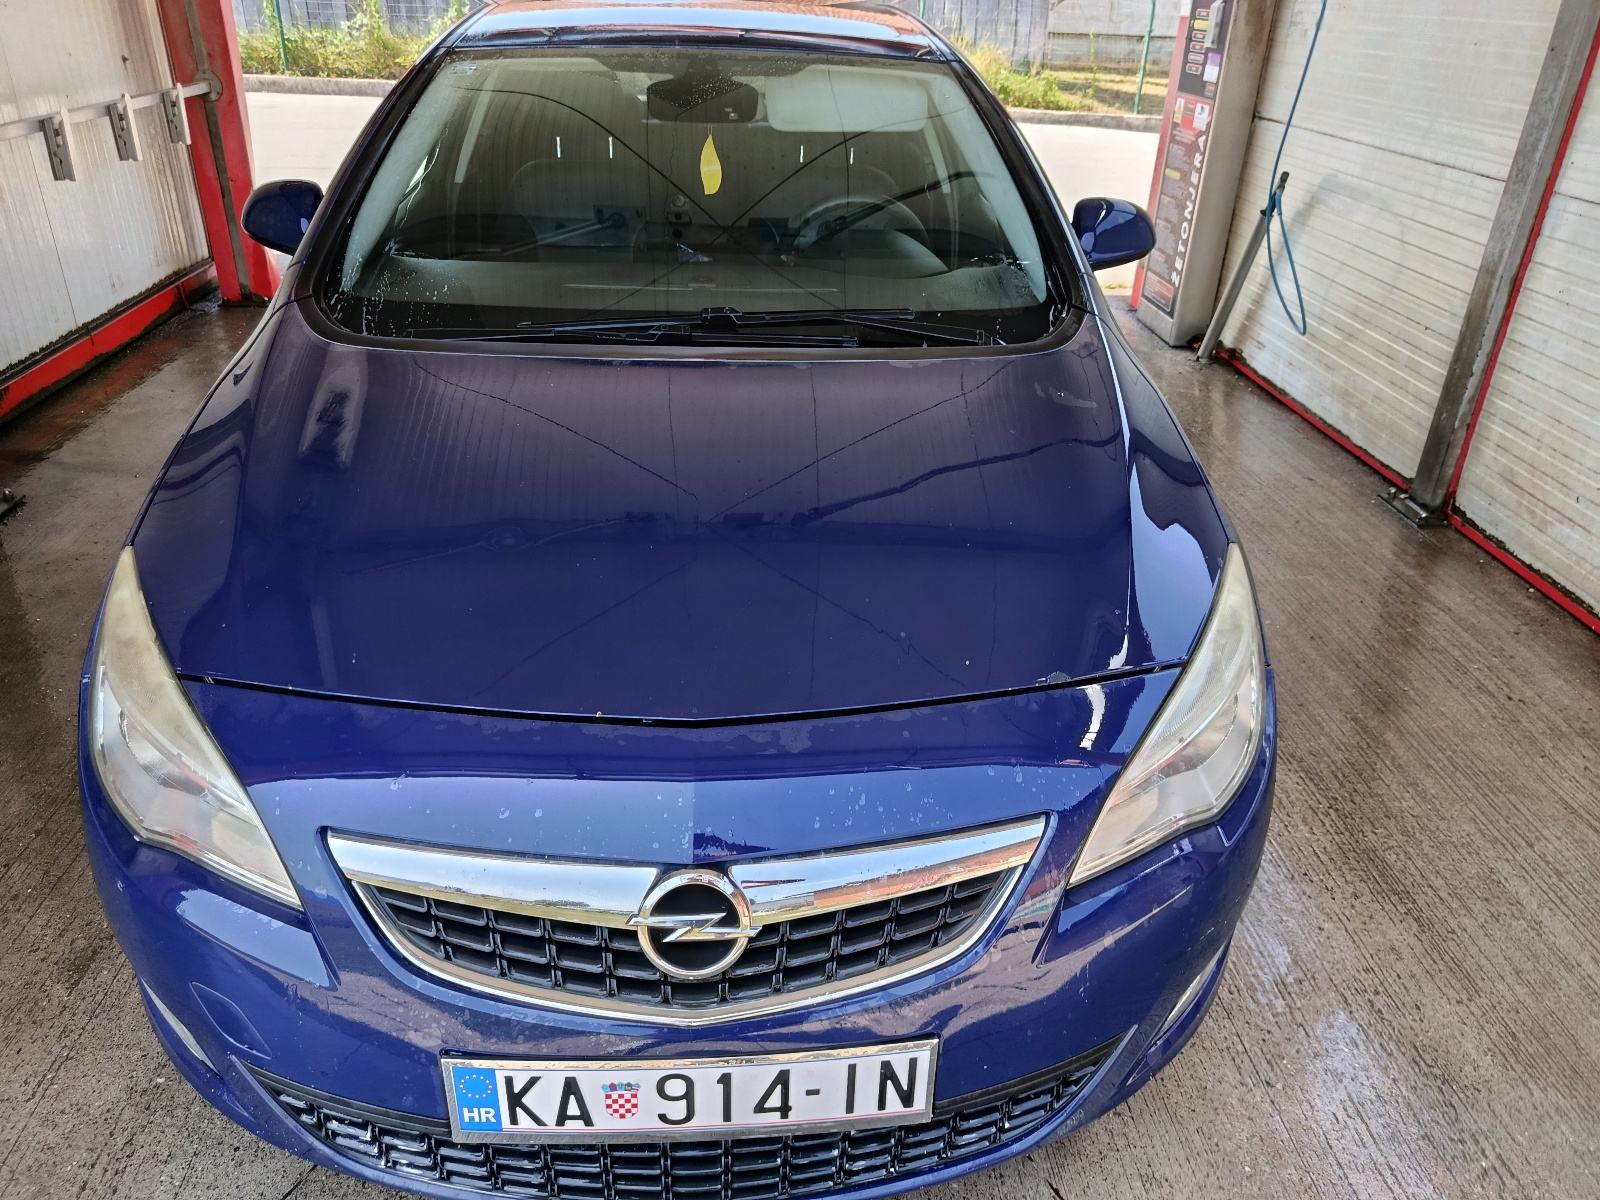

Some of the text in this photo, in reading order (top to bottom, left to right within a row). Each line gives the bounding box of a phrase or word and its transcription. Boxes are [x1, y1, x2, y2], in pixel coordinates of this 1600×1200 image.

[1171, 135, 1206, 287] ŽETONJERA
[463, 1106, 497, 1124] HR
[503, 1056, 918, 1128] KA 914-IN
